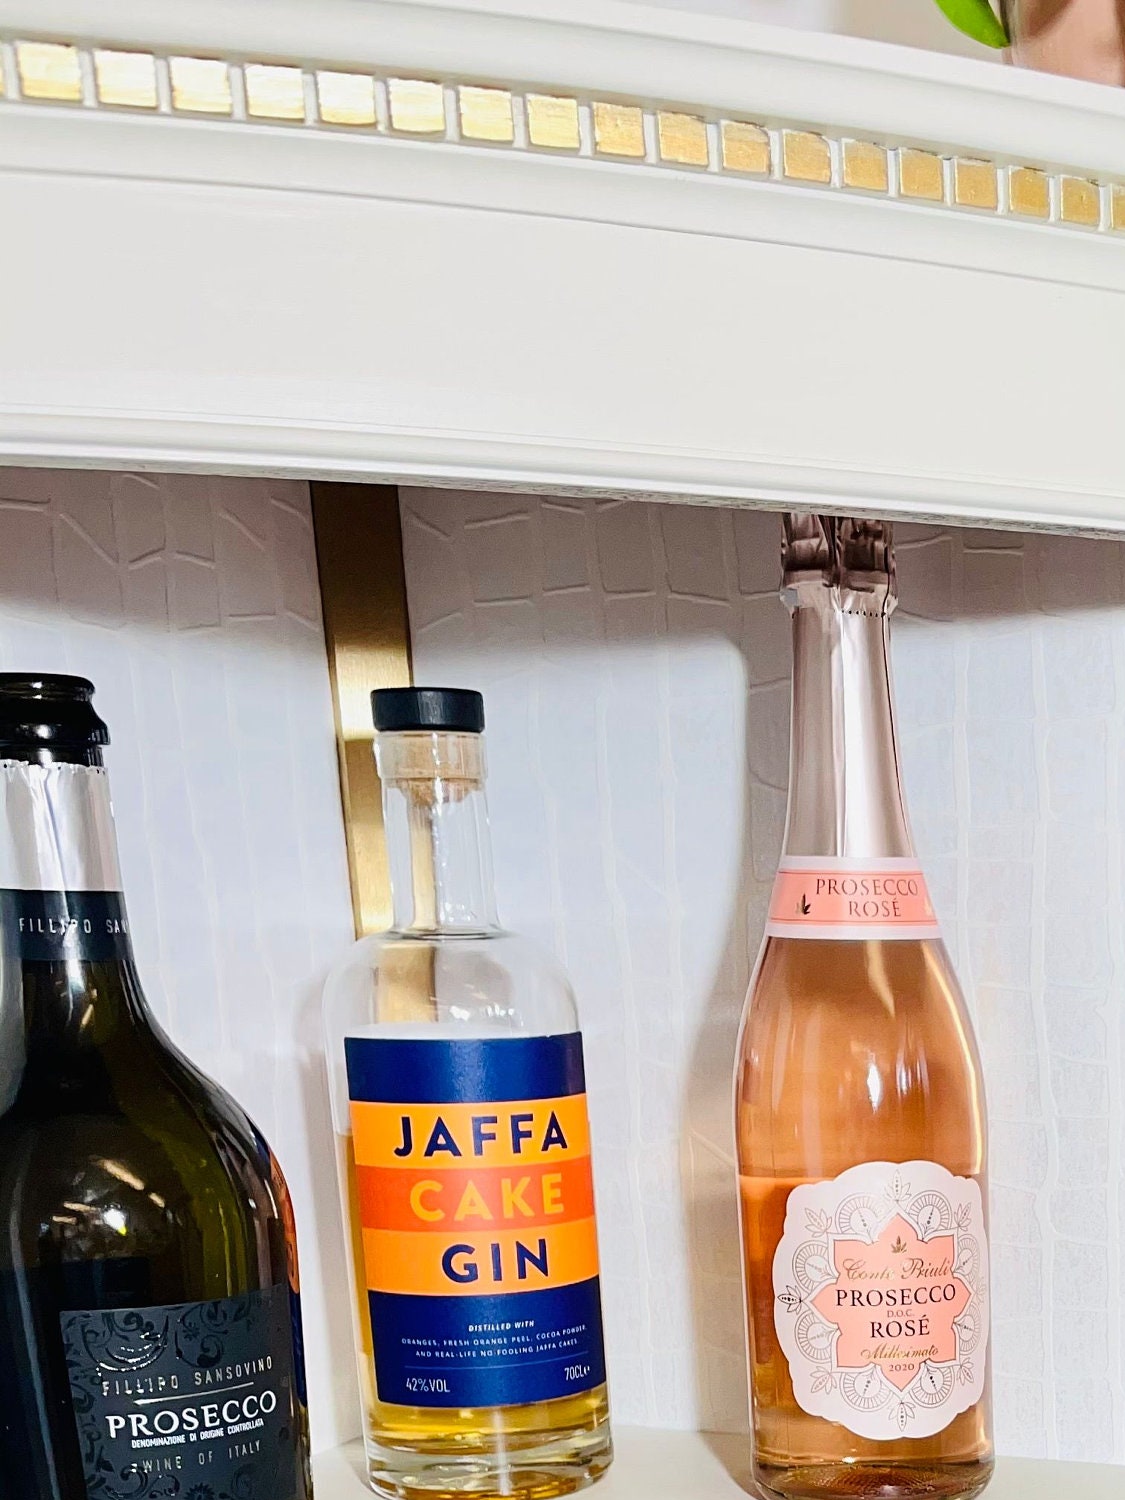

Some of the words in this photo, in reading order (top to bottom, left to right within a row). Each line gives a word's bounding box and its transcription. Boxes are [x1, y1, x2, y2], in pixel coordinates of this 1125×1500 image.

[815, 877, 919, 897] PROSECCO
[849, 898, 902, 918] ROSÉ
[394, 1110, 568, 1158] JAFFA
[410, 1172, 565, 1222] CAKE
[441, 1238, 550, 1284] GIN
[836, 1283, 956, 1307] PROSECCO
[886, 1308, 916, 1318] D.O.C.
[467, 1322, 512, 1333] DISTILLED
[514, 1319, 535, 1330] WITH
[473, 1336, 508, 1347] ORANGE
[535, 1329, 561, 1341] COCOA
[870, 1314, 931, 1339] ROSÉ
[415, 1350, 432, 1358] AND
[860, 1342, 939, 1360] Millesimato
[194, 1354, 273, 1386] SANSOVINO
[888, 1362, 916, 1372] 2020
[105, 1389, 277, 1439] PROSECCO
[131, 1433, 186, 1449] DENOMINAZIONE
[189, 1431, 198, 1442] DI
[200, 1426, 225, 1441] ORIGINE
[227, 1417, 265, 1436] CONTROLLATA
[141, 1455, 182, 1474] WINE
[198, 1450, 213, 1466] OF
[228, 1439, 261, 1460] ITALY
